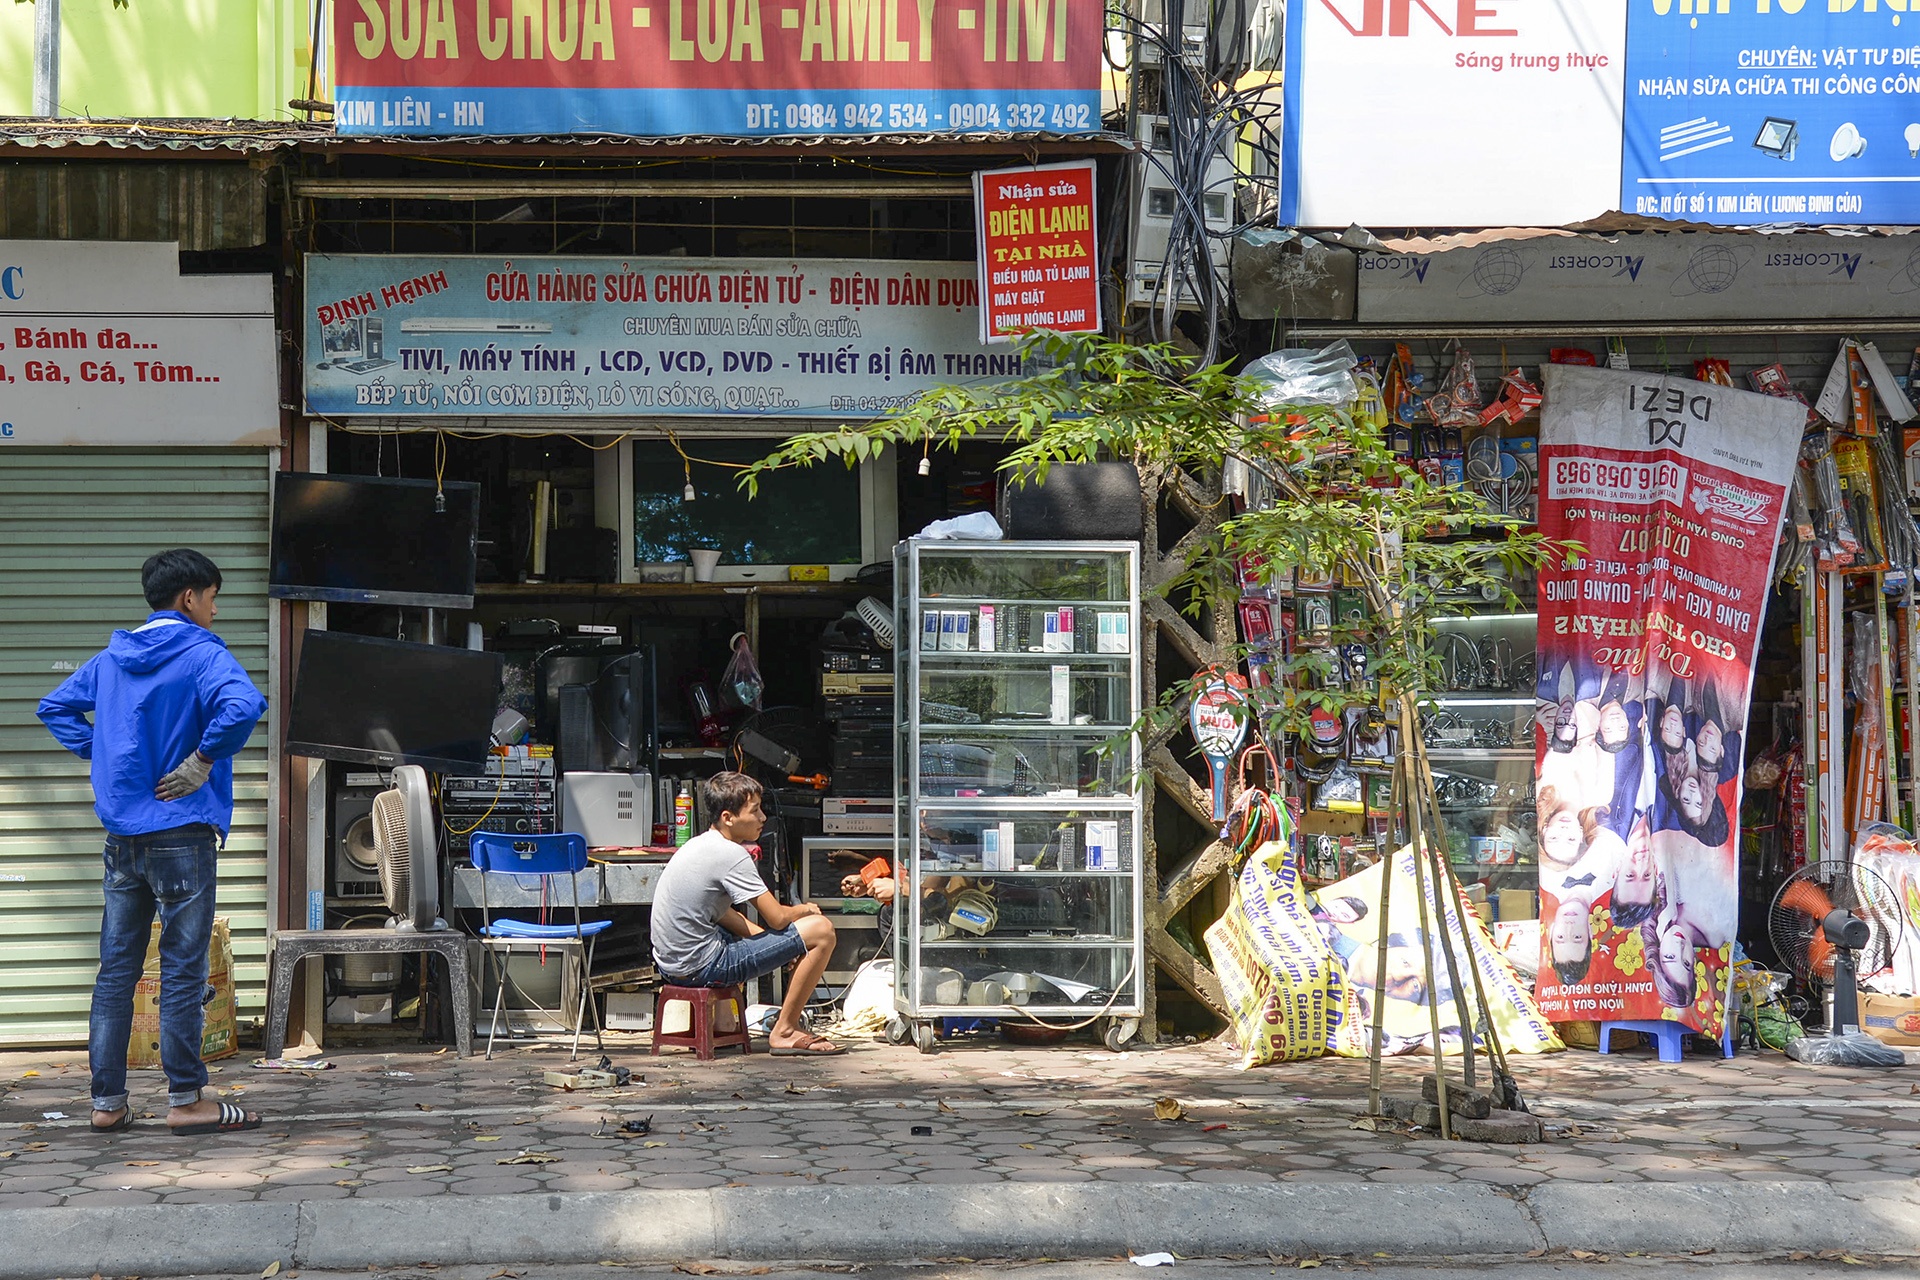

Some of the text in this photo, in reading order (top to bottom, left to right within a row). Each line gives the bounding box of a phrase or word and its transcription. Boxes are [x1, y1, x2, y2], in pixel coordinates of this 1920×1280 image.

[1455, 52, 1609, 72] Sáng trung thực
[1737, 46, 1817, 68] CHUYÊN:
[1822, 47, 1857, 69] VẬT
[1862, 48, 1889, 66] TƯ
[1638, 76, 1688, 100] NHẬN
[1692, 75, 1732, 96] SỬA
[1735, 75, 1788, 95] CHỮA
[1791, 78, 1820, 95] THI
[1824, 74, 1877, 95] CÔNG
[334, 96, 485, 127] KIM LIÊN HN
[746, 103, 1090, 128] ĐT: 0984 942 534 0904 332 492
[998, 180, 1077, 202] Nhận sửa
[1707, 197, 1713, 213] 1
[1716, 196, 1738, 213] KIM
[1739, 192, 1763, 213] LIÊN
[989, 204, 1090, 241] ĐIỆN LẠNH
[994, 240, 1087, 265] TẠI NHÀ
[993, 264, 1090, 285] ĐIỀU HÒA TỦ LẠNH
[1549, 256, 1645, 283] ALCOREST
[1765, 252, 1863, 280] ALCOREST
[0, 266, 25, 300] C
[486, 261, 979, 311] CỬA HÀNG SỬA CHỮA ĐIỆN TỬ ĐIỆN DÂN DỤN
[317, 269, 449, 326] ĐỊNH HẠNH
[994, 288, 1045, 307] MÁY GIẶT
[623, 312, 862, 338] CHUYÊN MUA BÁN SỬA CHỮA
[995, 308, 1086, 328] BÌNH NÓNG LẠNH
[14, 327, 158, 350] Bánh đa...
[400, 349, 450, 376] TIVI,
[459, 343, 512, 372] MÁY
[520, 343, 575, 372] TÍNH
[601, 350, 651, 376] LCD,
[658, 350, 714, 377] VCD,
[722, 350, 773, 373] DVD
[798, 344, 860, 375] THIẾT
[900, 347, 936, 376] ÂM
[943, 353, 1022, 376] THANH
[24, 360, 71, 385] Gà,
[79, 360, 125, 385] Cá,
[133, 360, 221, 383] Tôm...
[356, 376, 397, 406] BẾP
[401, 379, 438, 410] TỪ,
[443, 376, 482, 406] NỒI
[486, 383, 531, 406] CƠM
[535, 379, 593, 411] ĐIỆN,
[598, 379, 624, 406] LÒ
[629, 385, 653, 406] VI
[657, 381, 721, 411] SÓNG,
[830, 395, 856, 411] ĐT:
[1629, 385, 1712, 422] DEZI
[1565, 505, 1587, 521] NỘI
[1590, 509, 1606, 524] HÀ
[1608, 511, 1642, 523] NGHỊ
[1687, 521, 1709, 538] VĂN
[1710, 531, 1745, 549] CUNG
[1584, 579, 1632, 604] QUANG
[1555, 616, 1568, 635] 2
[1572, 614, 1645, 639] NHÂN
[1691, 630, 1737, 661] CHO
[1594, 980, 1623, 994] TẶNG
[1625, 982, 1653, 996] DÀNH
[1296, 993, 1310, 1041] Giáng
[1310, 989, 1324, 1042] Quang
[1564, 1000, 1570, 1012] Ý
[1573, 999, 1597, 1012] QUÀ
[1599, 998, 1624, 1012] MÓN
